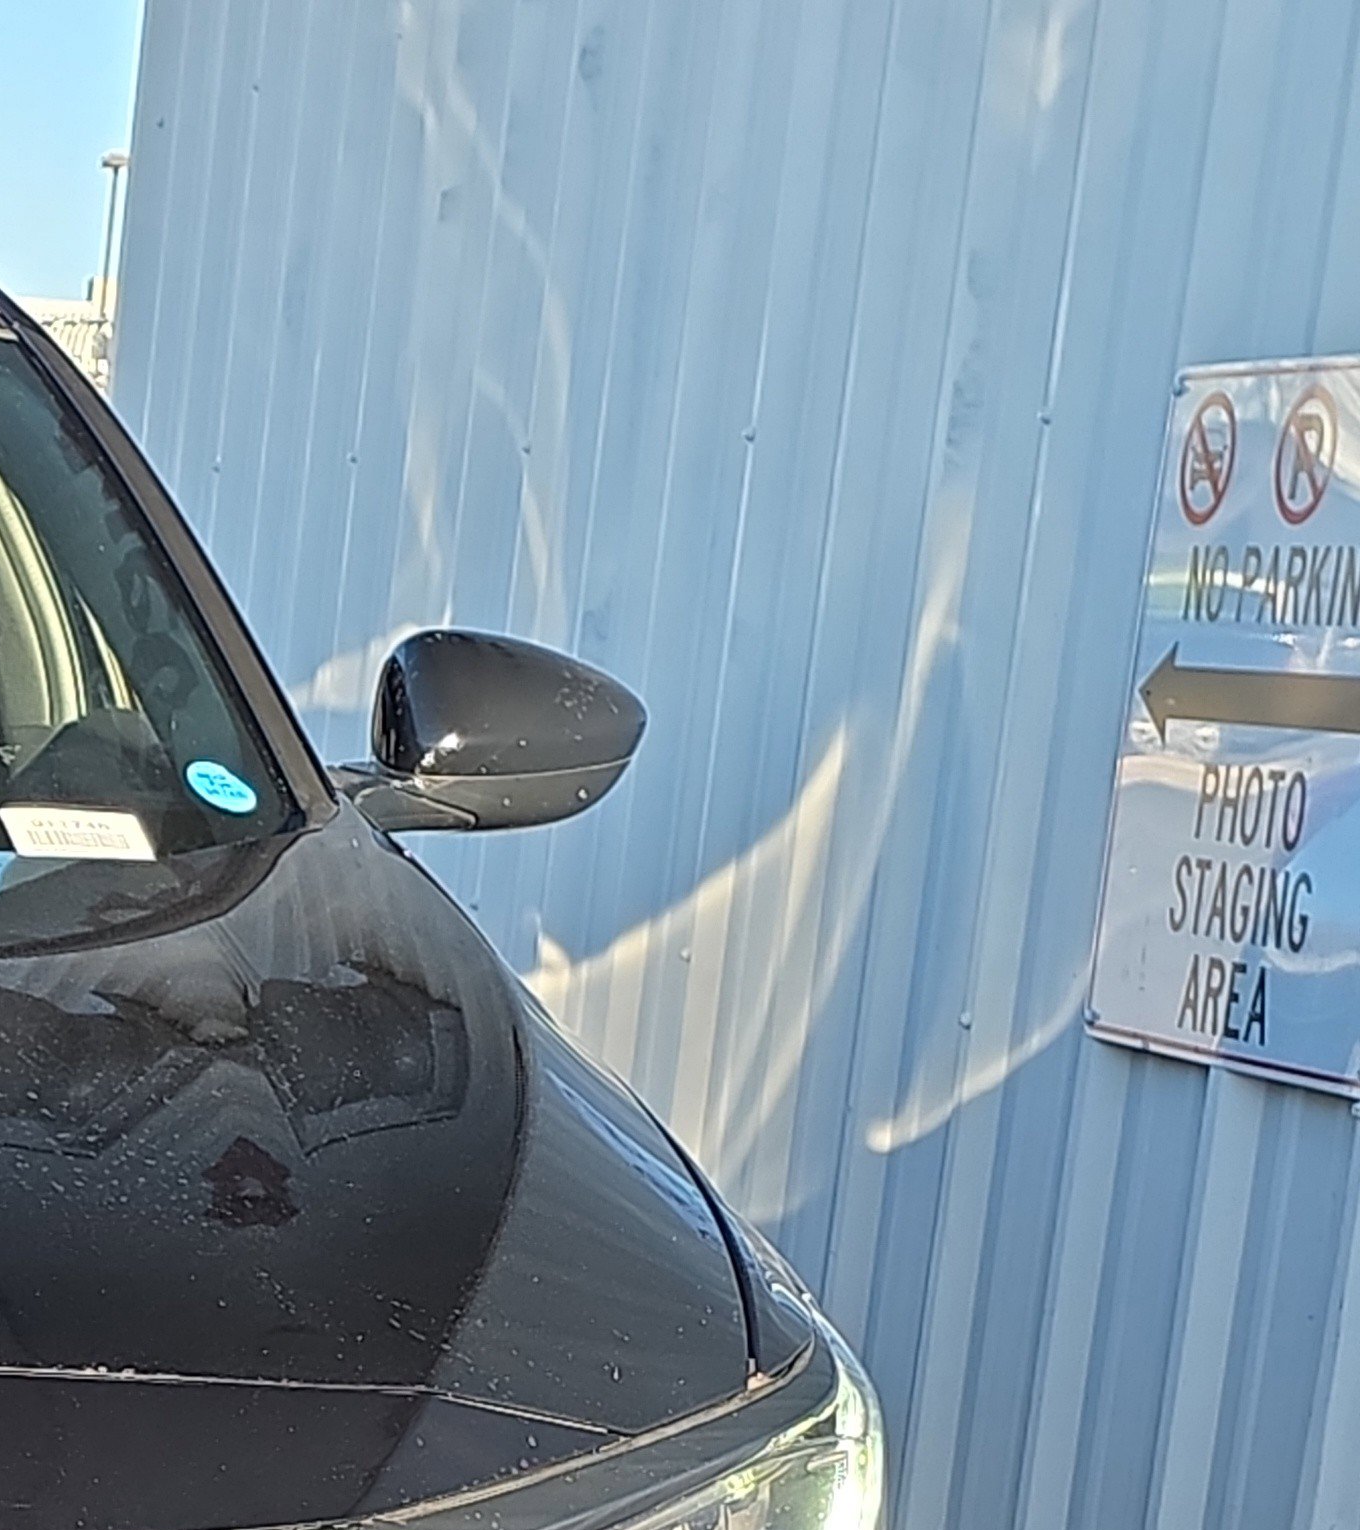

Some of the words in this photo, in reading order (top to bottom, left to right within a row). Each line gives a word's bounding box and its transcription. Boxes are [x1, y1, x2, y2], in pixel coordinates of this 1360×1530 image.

[1182, 544, 1230, 622] NO
[1194, 764, 1307, 851] PHOTO
[1169, 855, 1313, 953] STAGING
[1177, 953, 1266, 1047] AREA
